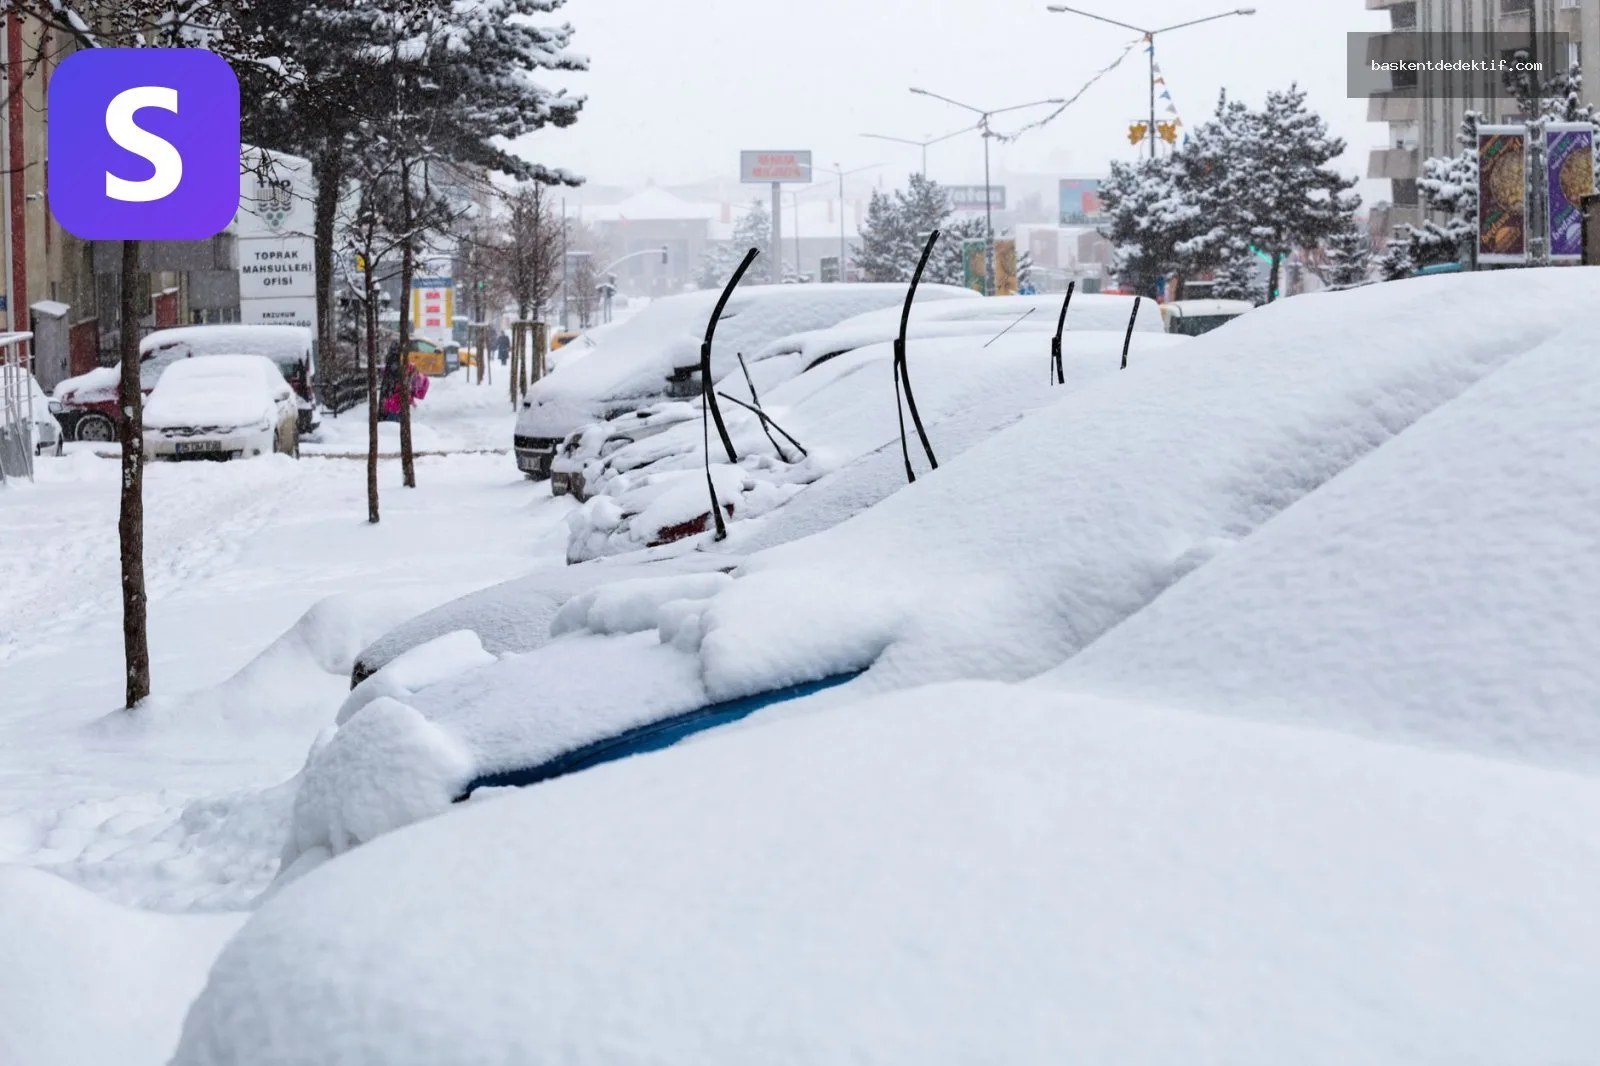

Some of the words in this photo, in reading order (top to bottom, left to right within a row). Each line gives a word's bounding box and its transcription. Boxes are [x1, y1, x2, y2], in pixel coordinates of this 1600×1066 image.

[254, 250, 299, 261] TOPRAK
[242, 260, 313, 274] MAHSULLERİ
[263, 275, 293, 287] OFİSİ
[262, 311, 296, 319] ERZURUM
